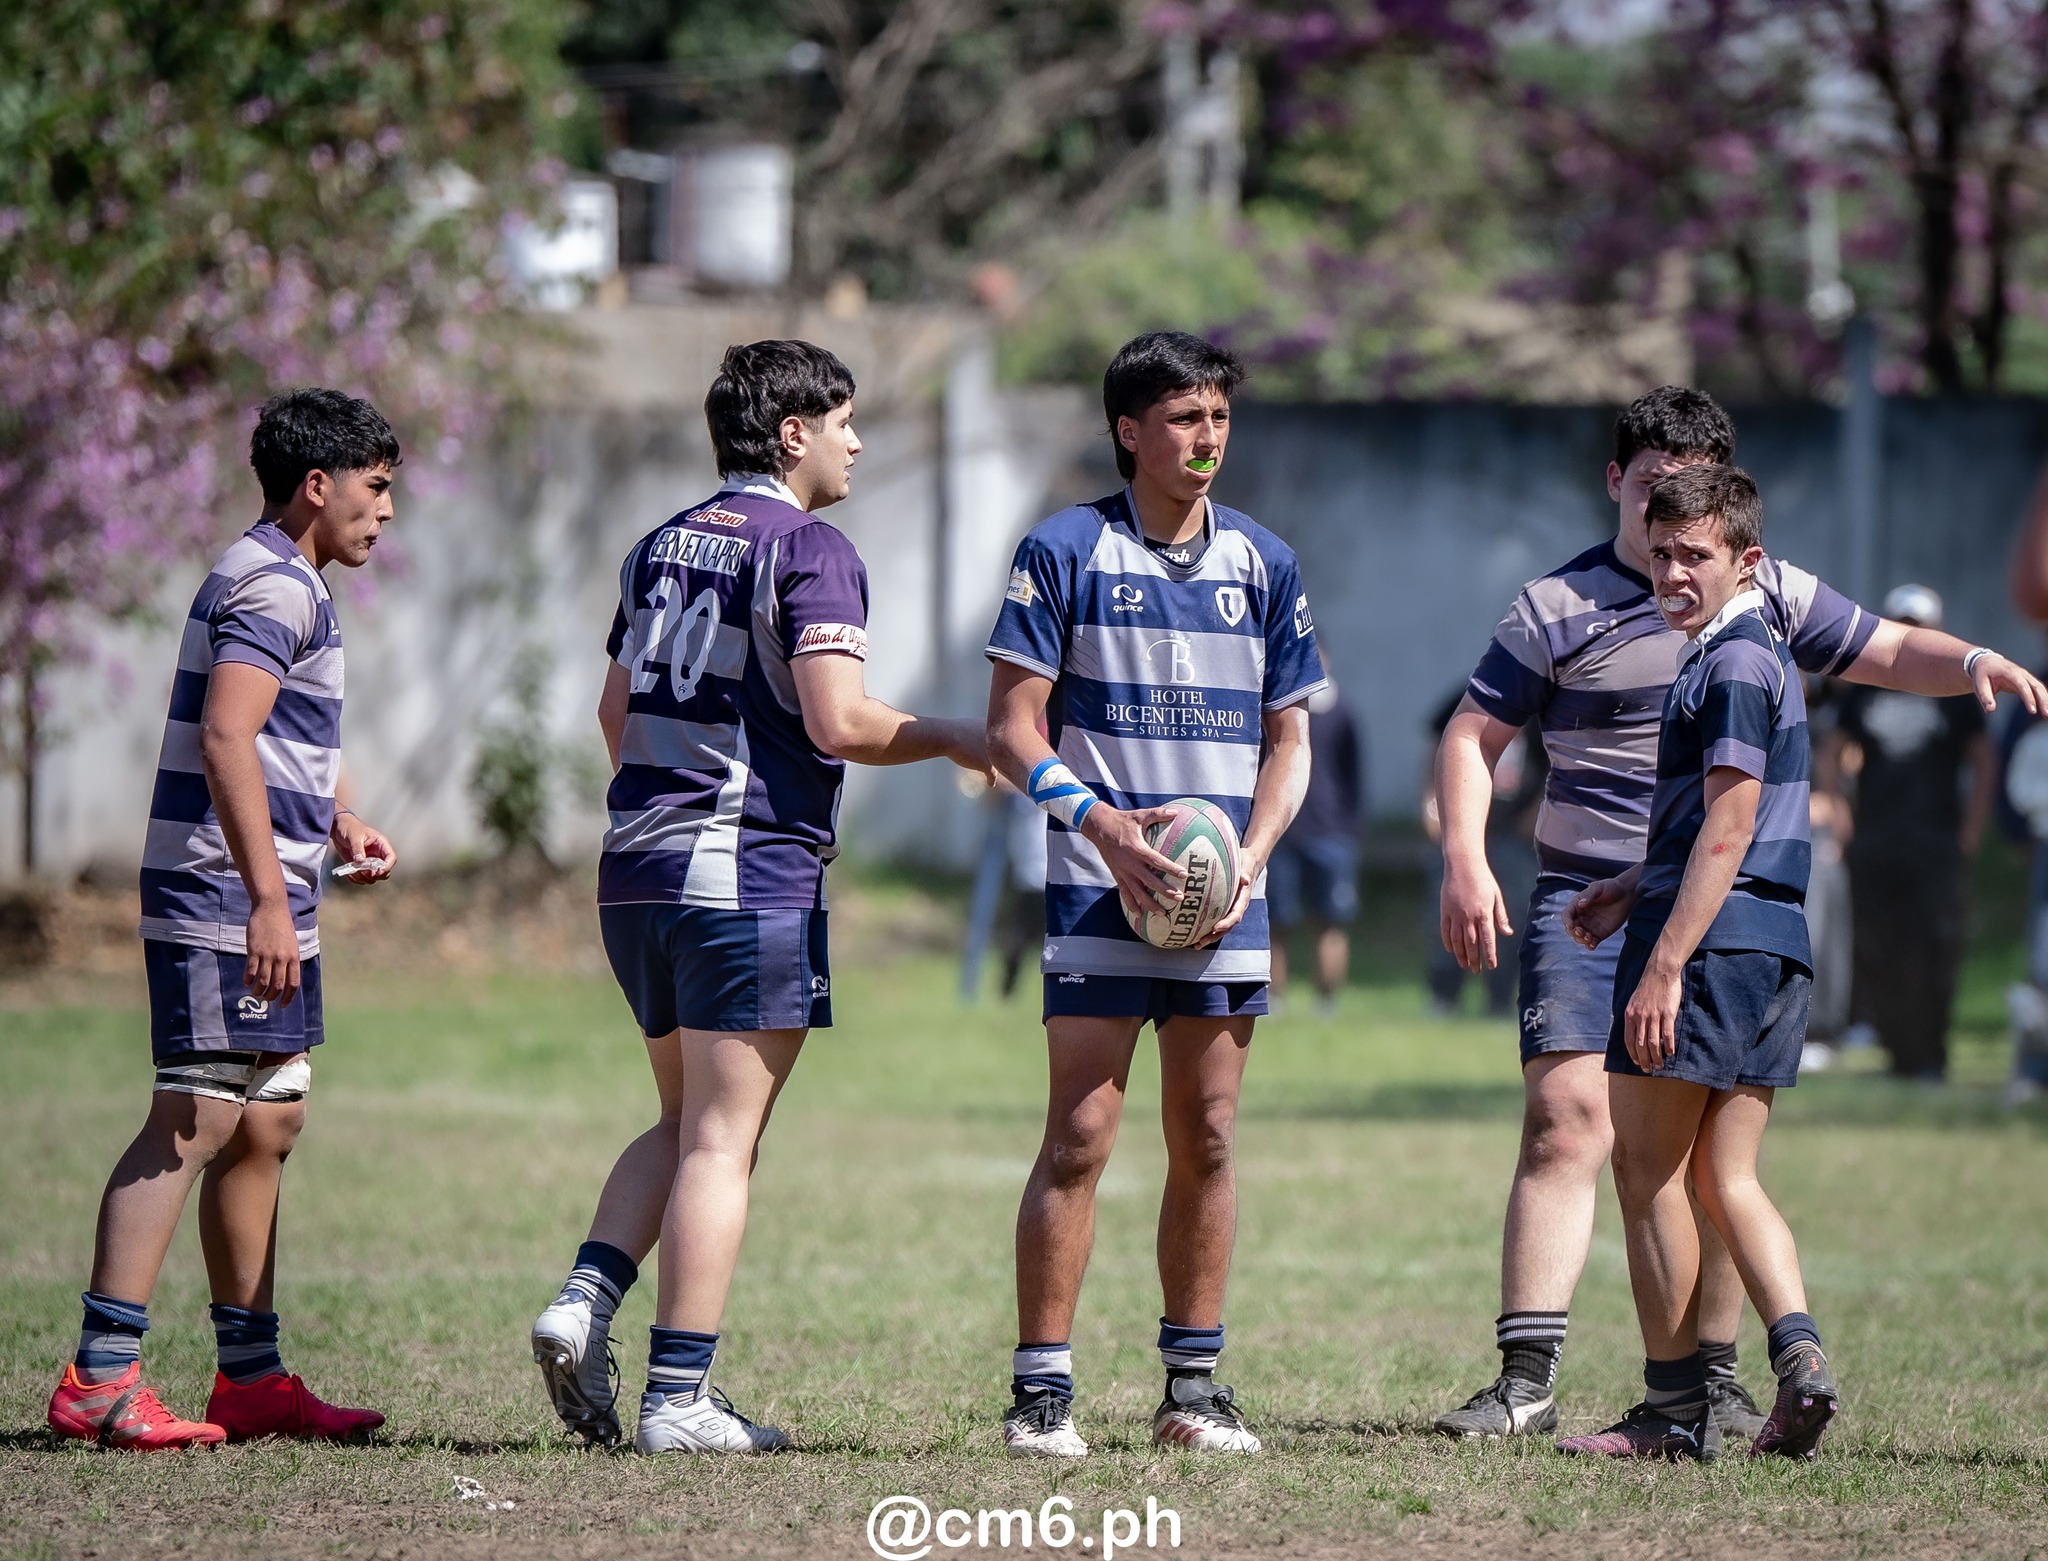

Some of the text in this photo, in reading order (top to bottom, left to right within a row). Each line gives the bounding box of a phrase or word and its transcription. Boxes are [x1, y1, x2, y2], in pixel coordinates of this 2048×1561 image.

[703, 537, 746, 572] CAPRI
[1112, 602, 1144, 614] quince
[630, 576, 721, 703] 20
[1150, 689, 1207, 705] HOTEL
[1105, 703, 1244, 729] BICENTENARIO
[1139, 725, 1220, 738] SUITES & SPA
[1059, 974, 1086, 984] quince
[239, 1011, 268, 1020] quince
